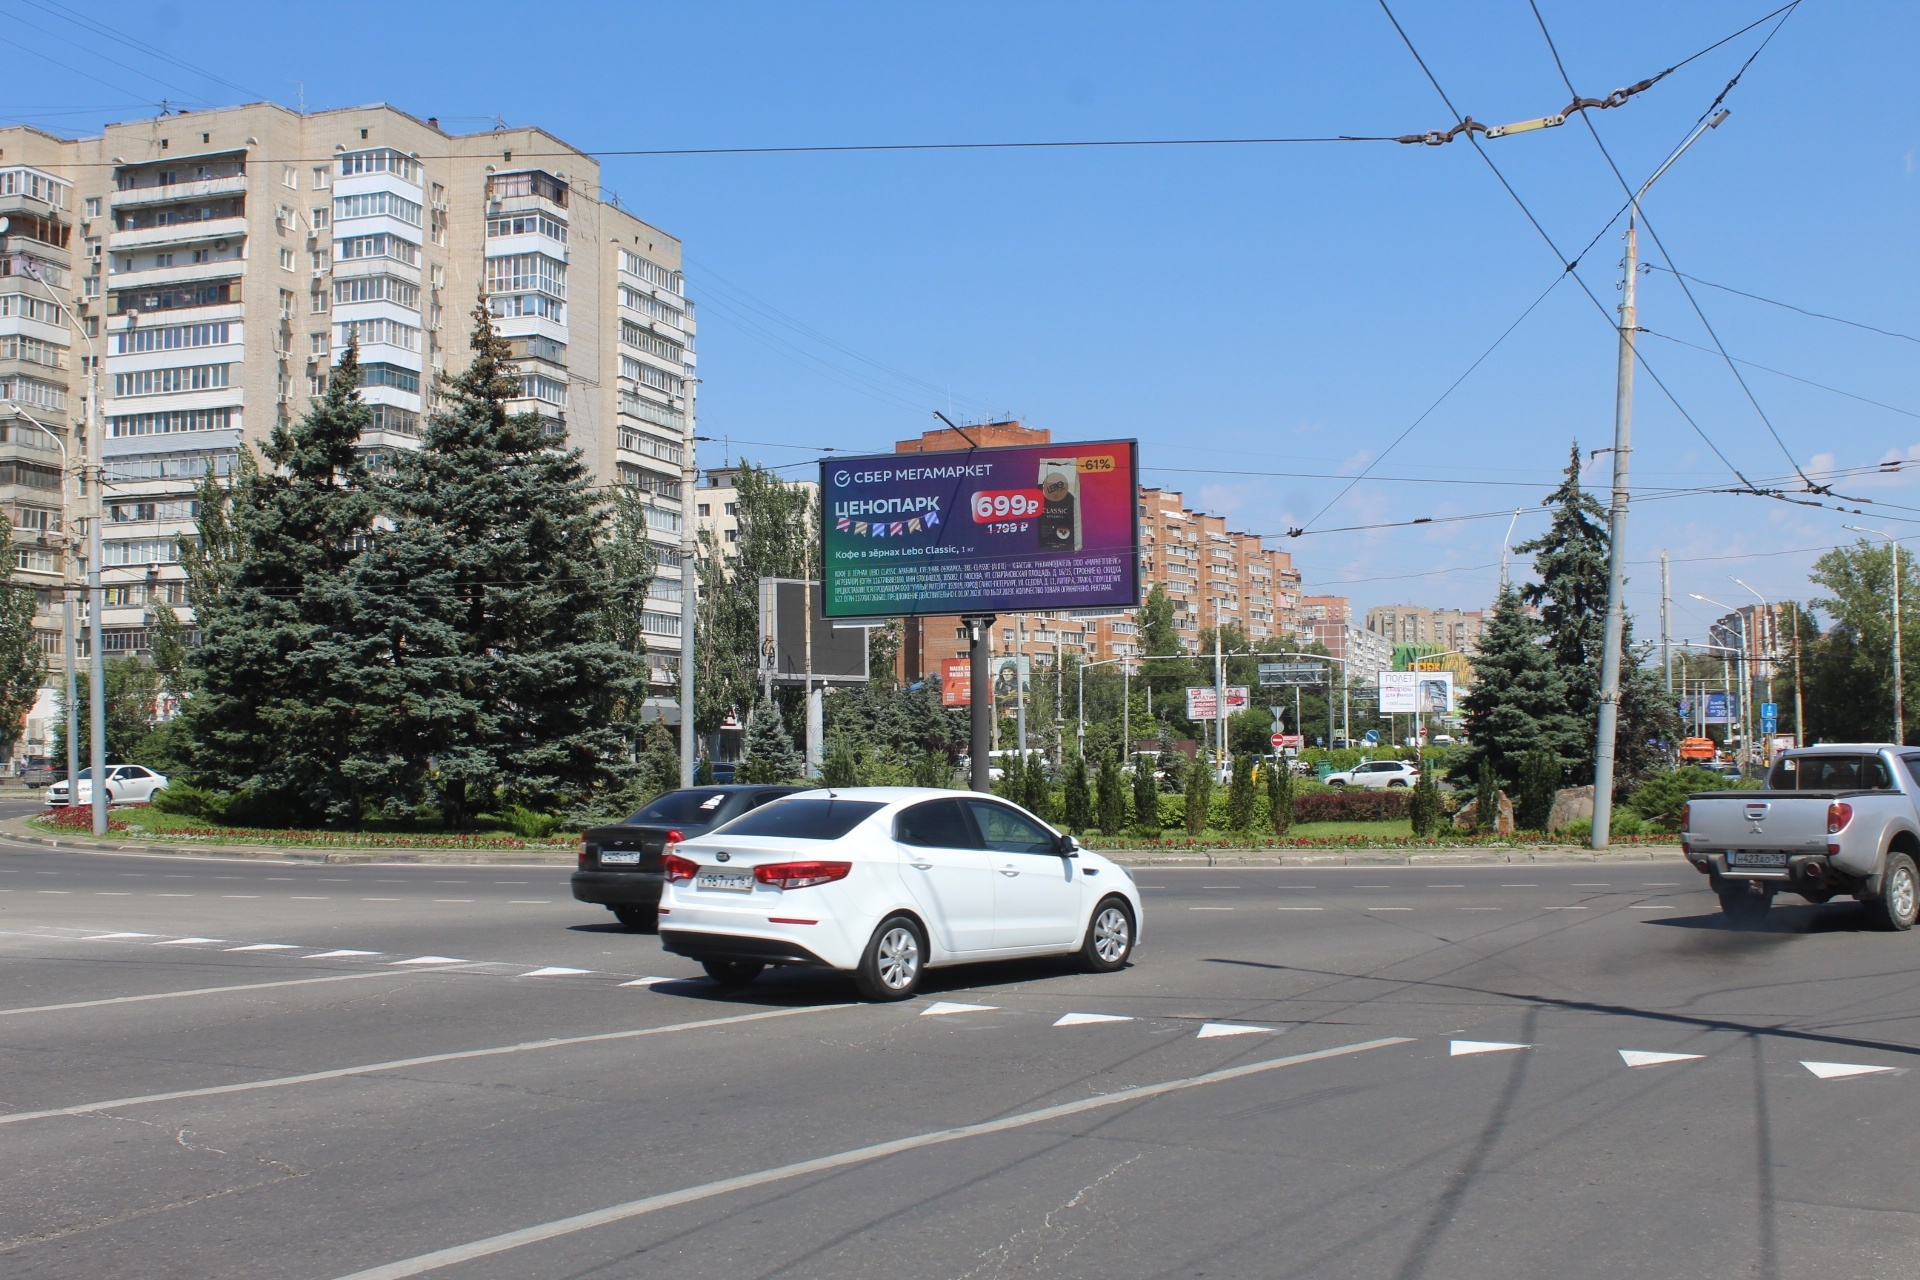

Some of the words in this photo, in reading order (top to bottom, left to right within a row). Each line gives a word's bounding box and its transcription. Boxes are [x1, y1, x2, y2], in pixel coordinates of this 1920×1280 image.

[1081, 459, 1110, 470] -61%
[854, 470, 892, 484] СБЕР
[896, 464, 993, 481] МЕГАМАРКЕТ
[835, 496, 940, 518] ЦЕНОПАРК
[836, 550, 860, 560] Кофе
[868, 548, 900, 558] зёрнах
[902, 547, 924, 556] Lebo
[925, 545, 960, 554] Classic,
